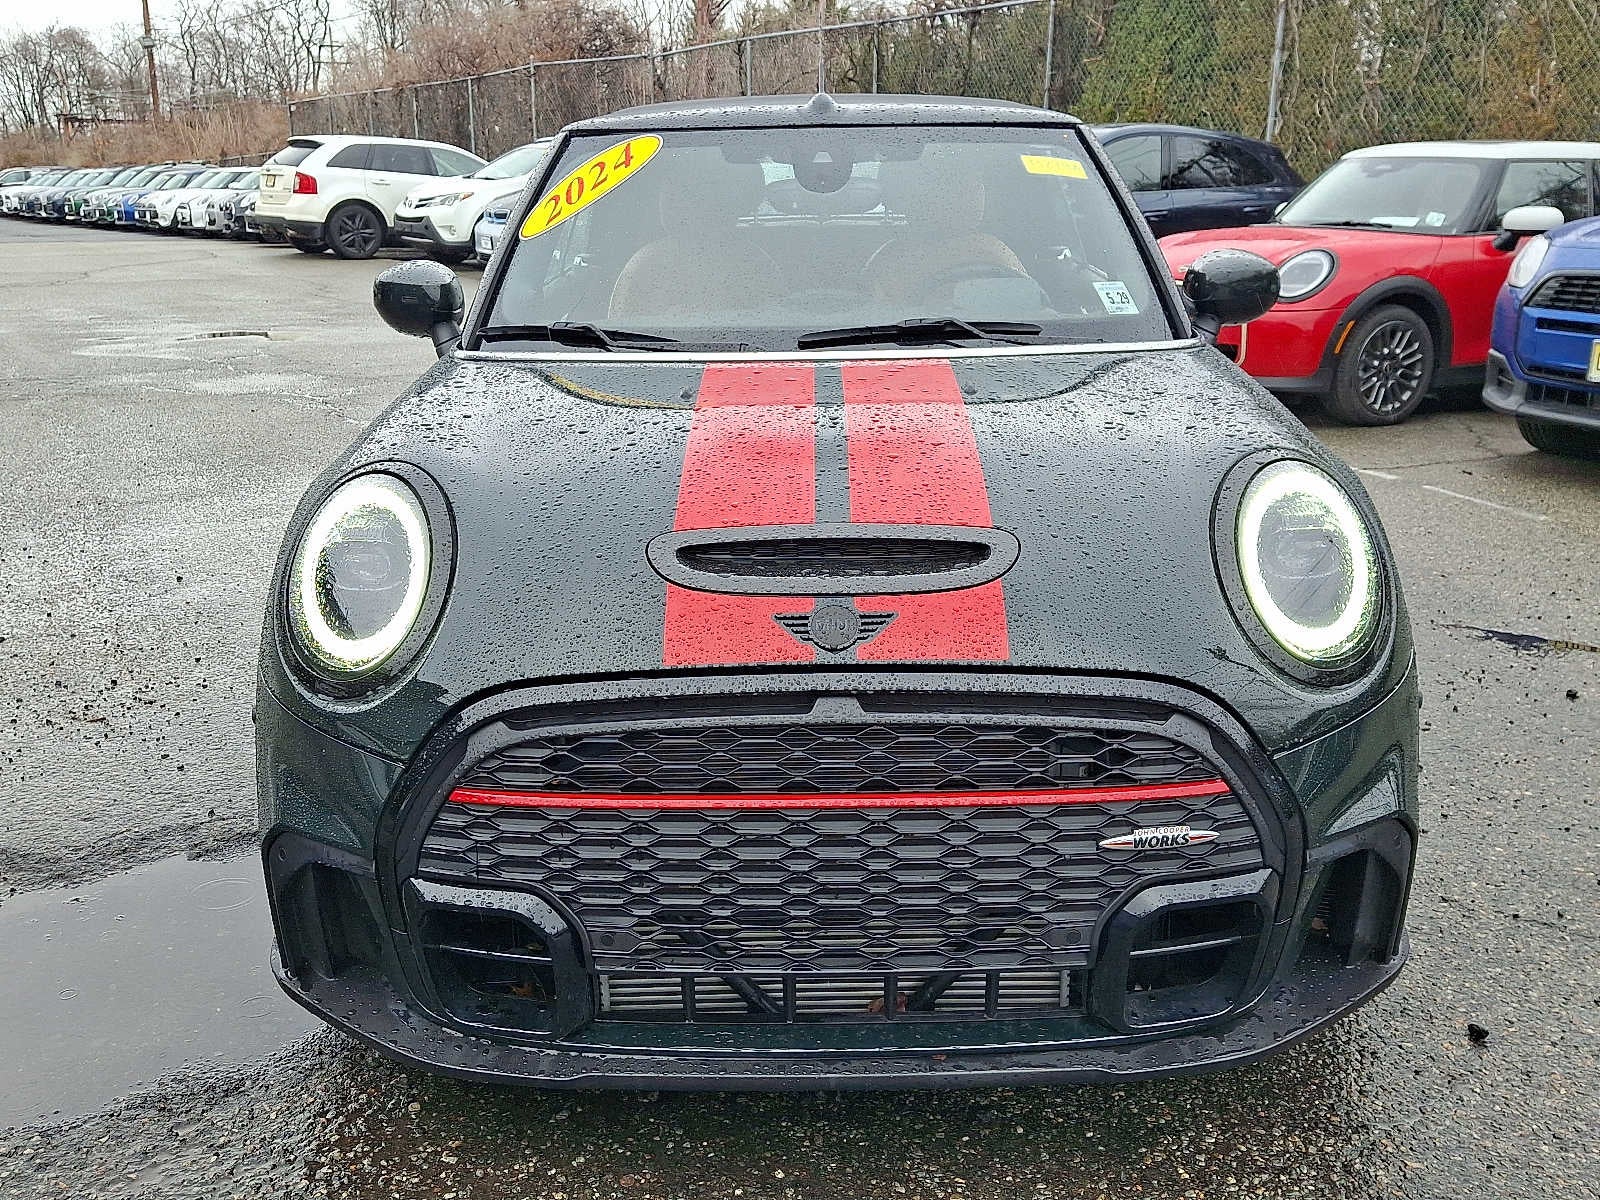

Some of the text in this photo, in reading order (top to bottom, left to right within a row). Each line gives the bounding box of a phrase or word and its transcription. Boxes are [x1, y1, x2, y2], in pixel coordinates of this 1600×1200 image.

[544, 143, 633, 226] 2024
[1133, 826, 1190, 837] JOHN COOPER
[1133, 833, 1190, 849] WORKS
